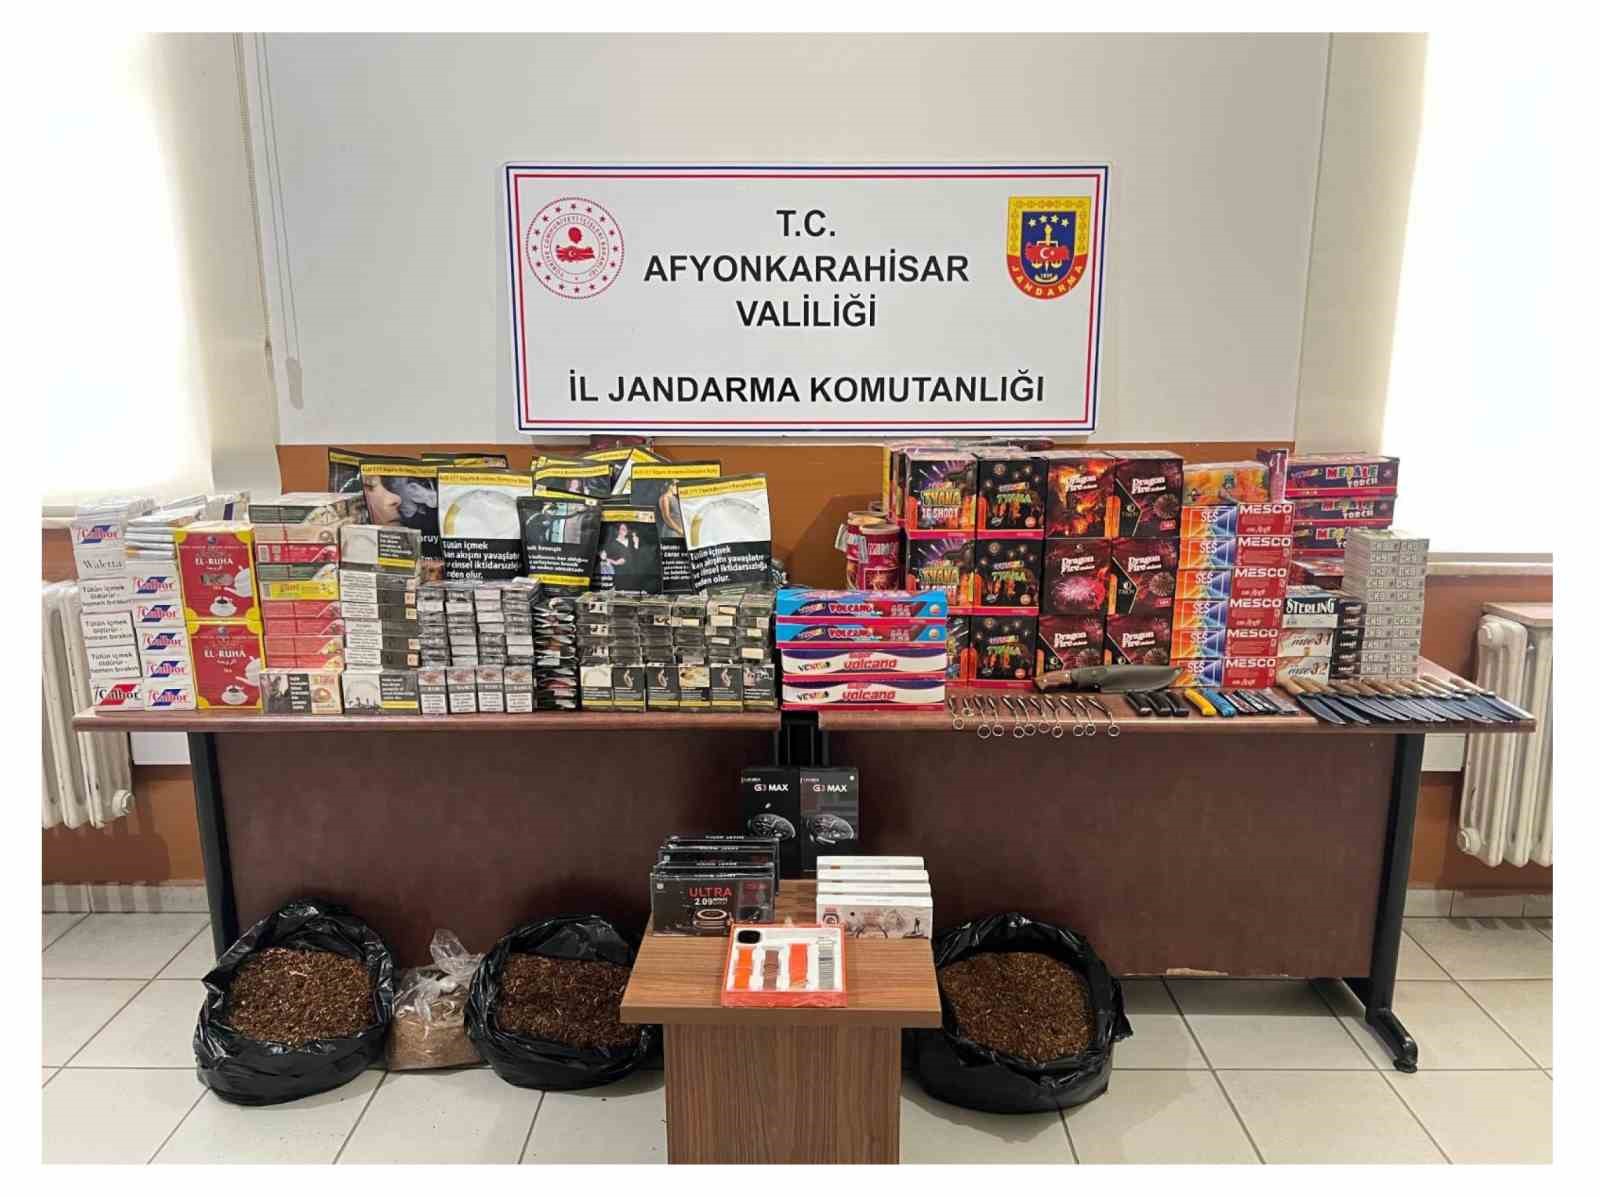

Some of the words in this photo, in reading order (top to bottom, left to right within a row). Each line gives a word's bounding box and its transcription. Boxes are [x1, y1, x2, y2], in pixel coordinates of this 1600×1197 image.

[776, 209, 836, 238] T.C.
[643, 247, 970, 283] AFYONKARAHİSAR
[1010, 265, 1083, 297] JANDARMA
[736, 293, 878, 328] VALİLİĞİ
[569, 369, 599, 402] İL
[608, 376, 801, 403] JANDARMA
[809, 369, 1045, 403] KOMUTANLIĞI
[1240, 504, 1292, 514] MESCO
[463, 540, 489, 550] içmek
[1238, 537, 1291, 547] MESCO
[1234, 568, 1287, 578] MESCO
[1230, 599, 1282, 608] MESCO
[1286, 597, 1337, 614] STERLING
[1227, 629, 1278, 638] MESCO
[843, 659, 897, 669] volcano
[1225, 658, 1276, 668] MESCO
[842, 689, 896, 700] volcano
[768, 783, 789, 792] MAX
[827, 784, 848, 793] MAX
[688, 887, 732, 897] ULTRA
